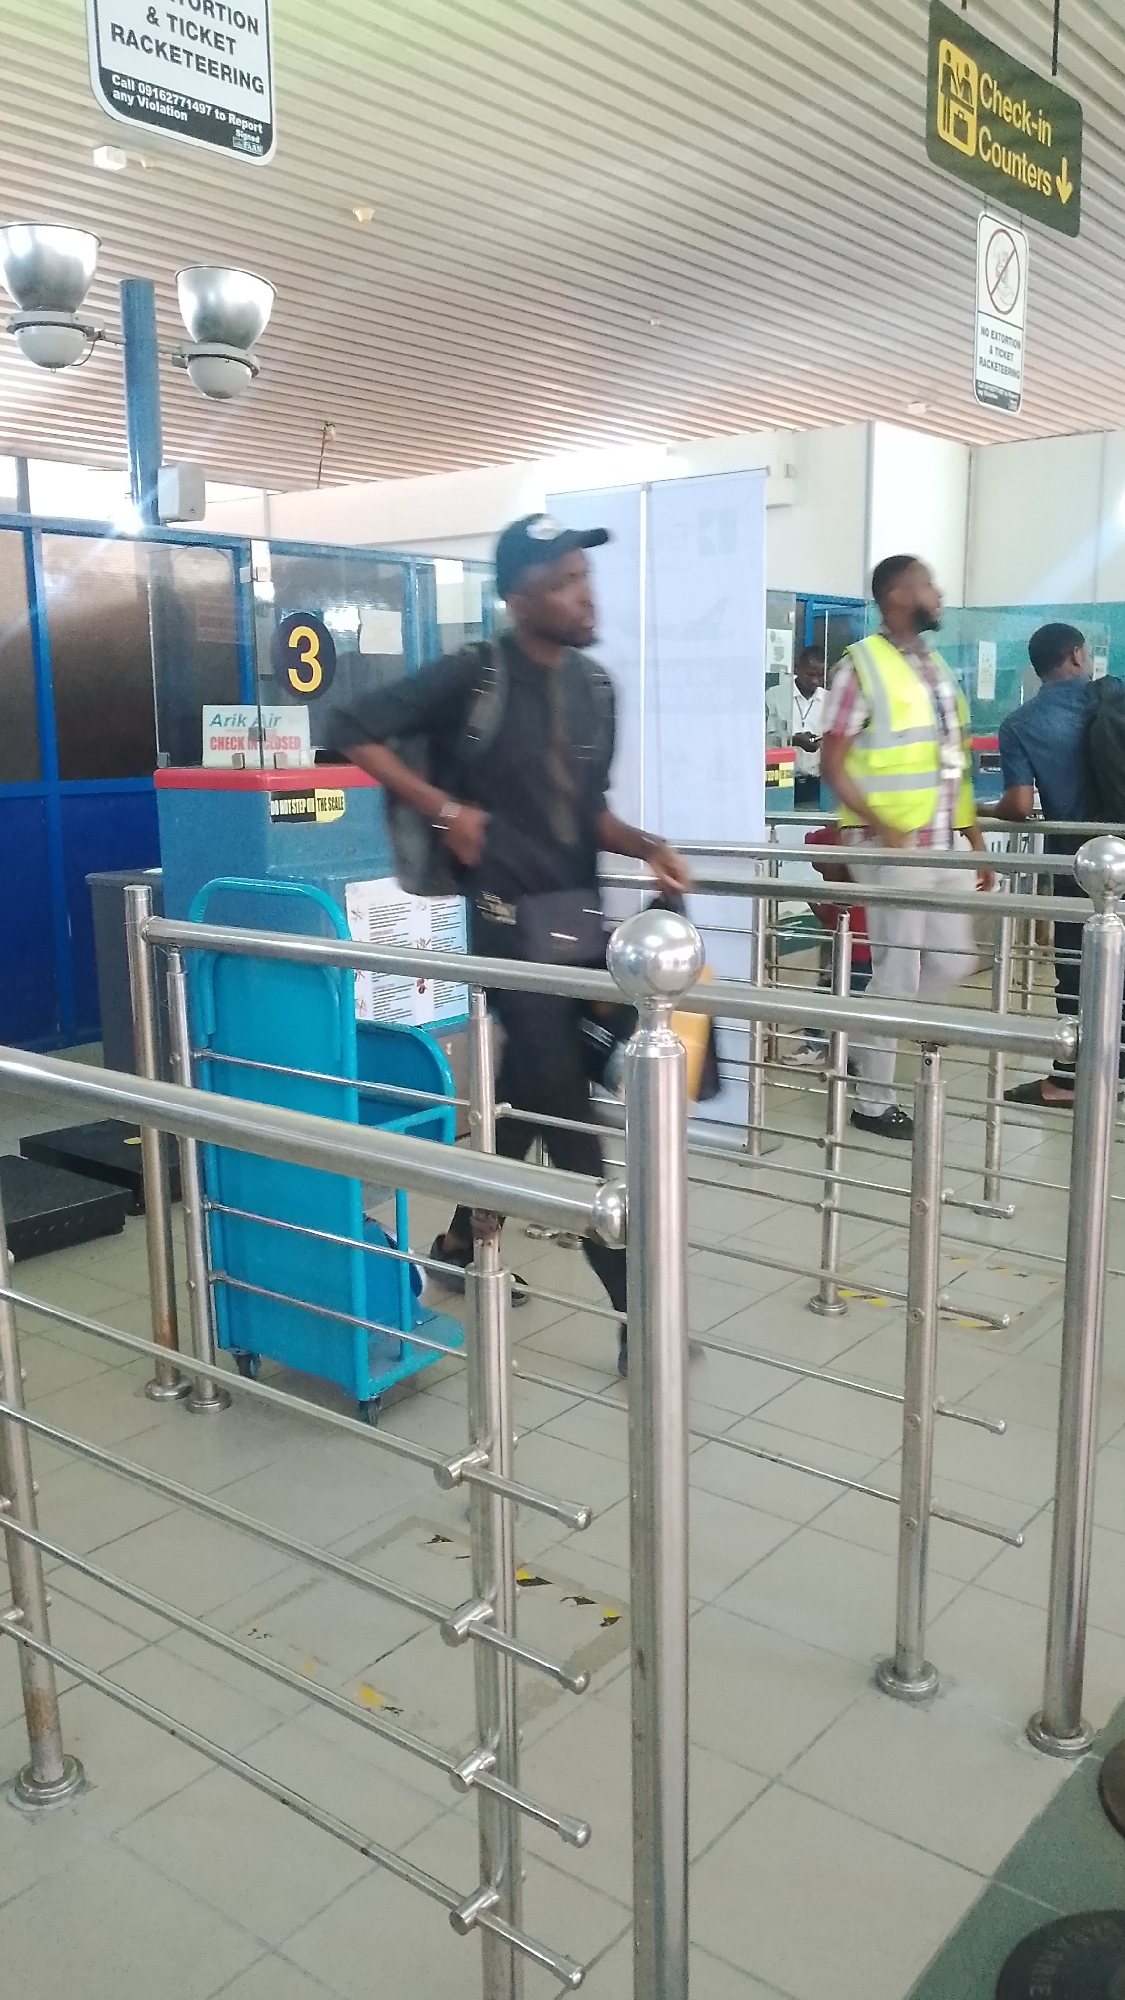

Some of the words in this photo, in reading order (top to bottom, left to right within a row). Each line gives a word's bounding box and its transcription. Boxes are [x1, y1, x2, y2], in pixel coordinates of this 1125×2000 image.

[146, 6, 160, 27] &
[166, 12, 237, 55] TICKET
[172, 0, 259, 36] ORTION
[110, 23, 265, 95] RACKETEERING
[112, 74, 135, 91] Call
[138, 82, 212, 116] 09162771497
[214, 108, 226, 121] to
[228, 113, 263, 134] Report
[112, 89, 134, 107] any
[136, 94, 188, 122] Violation
[979, 73, 1051, 147] Check-in
[978, 125, 1052, 196] Counters
[980, 326, 989, 337] NO
[990, 329, 1021, 350] EXTORTION
[995, 346, 1014, 361] TICKET
[979, 356, 1020, 379] RACKETEERING
[287, 625, 323, 693] 3
[209, 713, 248, 727] Arik
[251, 713, 282, 727] Air
[210, 736, 245, 750] CHECK
[263, 735, 301, 750] CLOSED
[270, 800, 280, 815] DO
[279, 799, 292, 814] NOT
[292, 797, 306, 813] STEP
[316, 797, 327, 812] THE
[327, 796, 344, 811] SCALE
